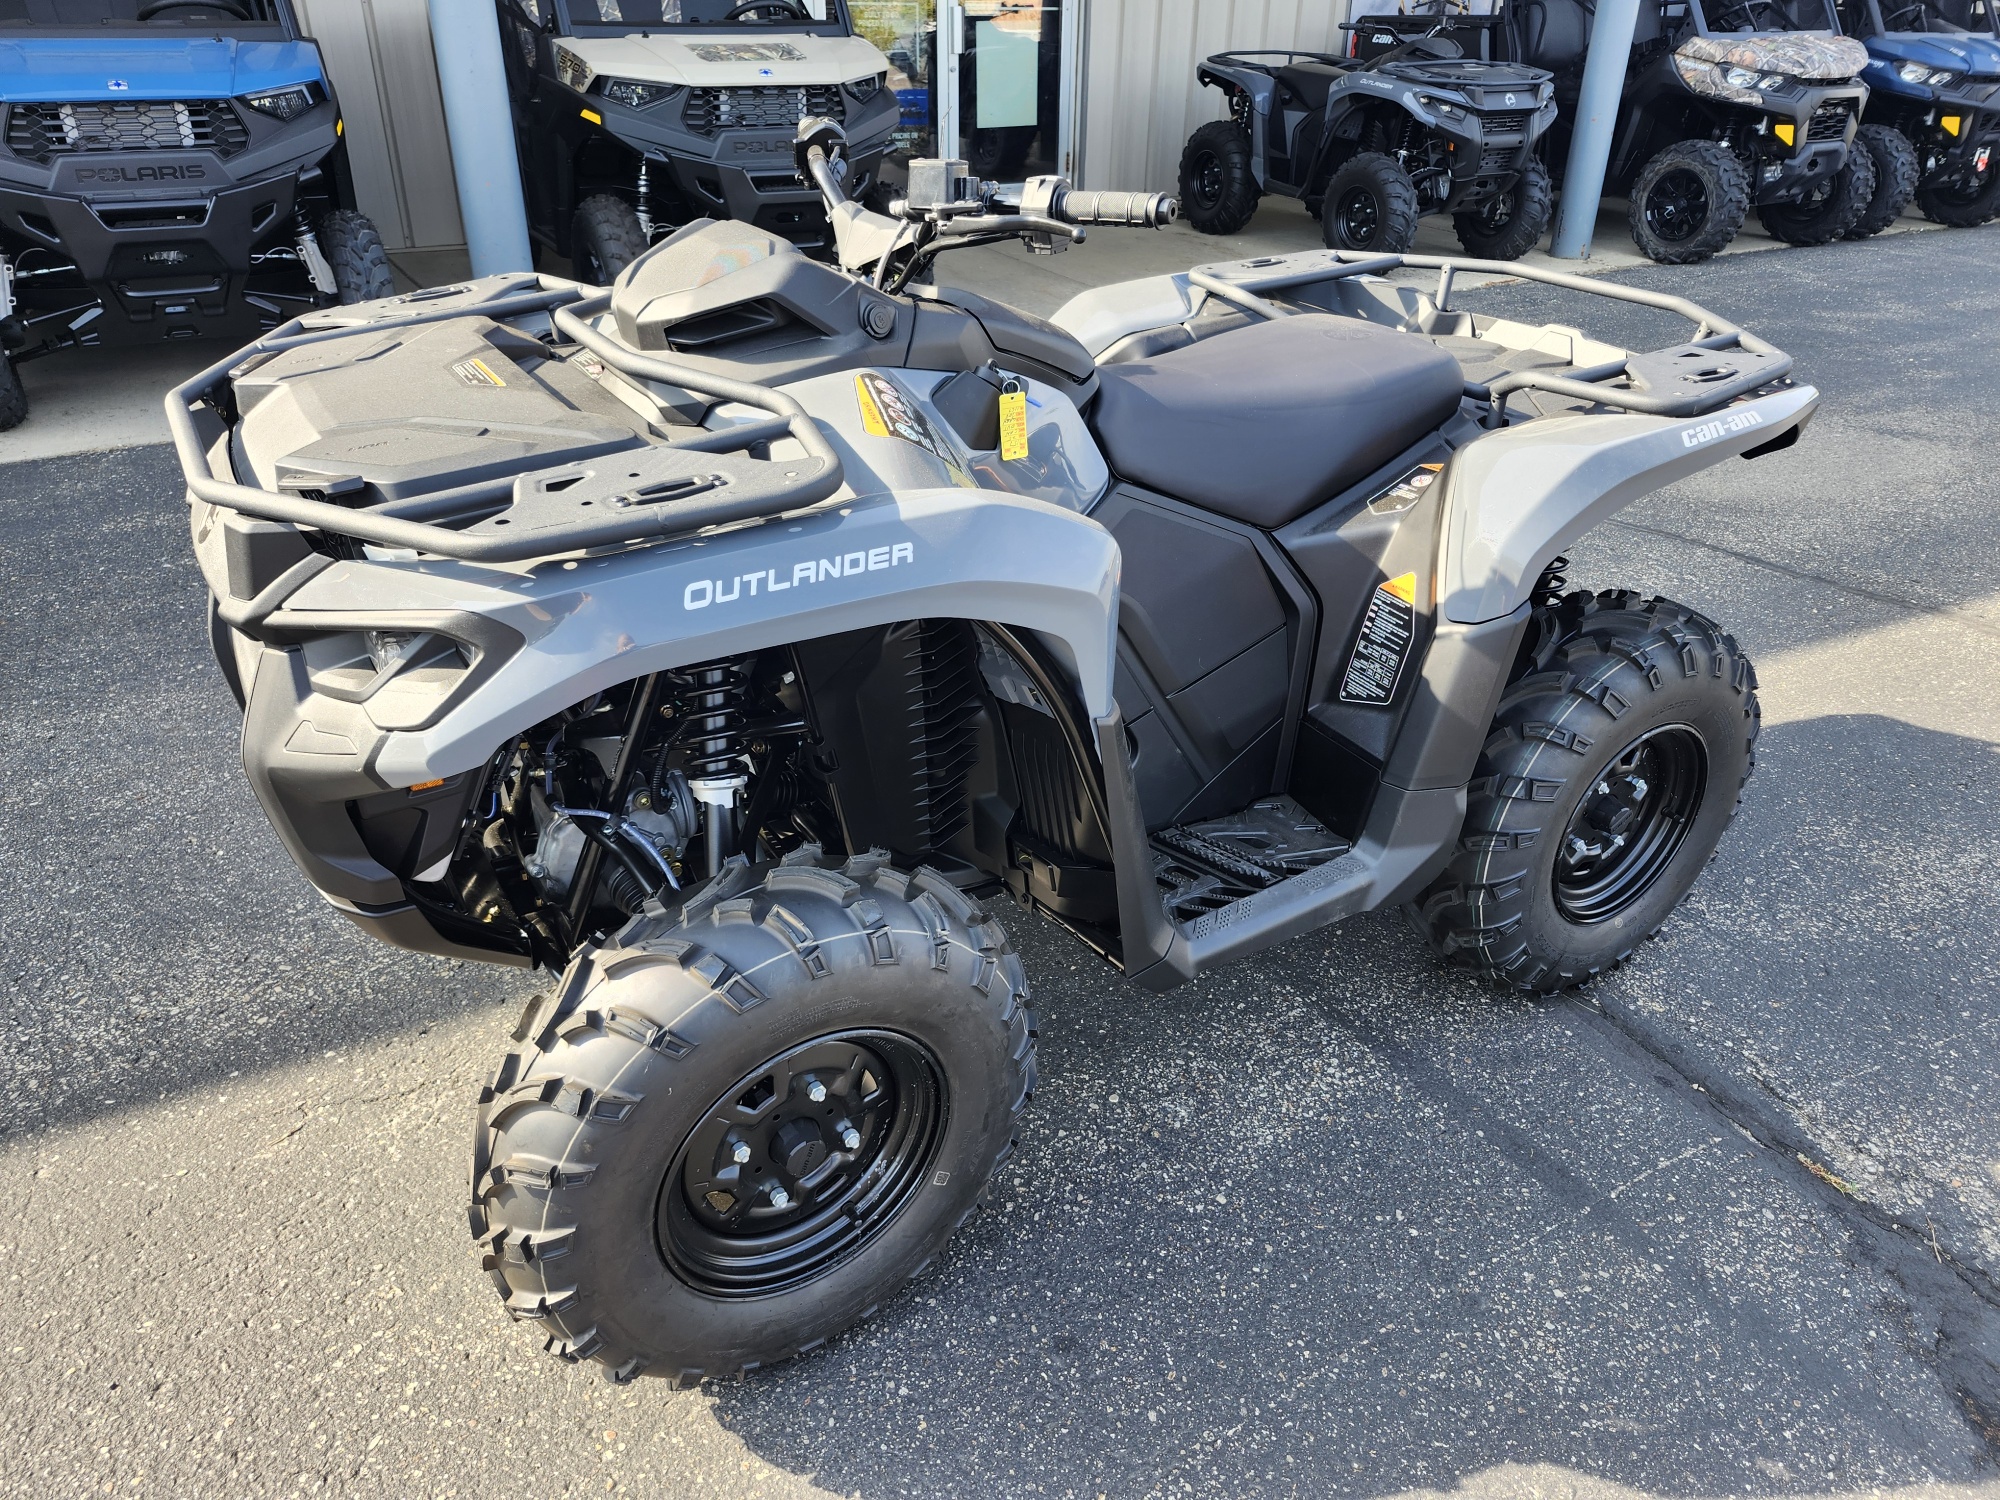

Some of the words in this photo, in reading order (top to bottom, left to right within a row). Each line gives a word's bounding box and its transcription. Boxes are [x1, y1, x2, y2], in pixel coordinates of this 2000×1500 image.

[559, 53, 581, 74] 570
[75, 164, 207, 184] POLARIS
[1681, 410, 1763, 448] can-am
[683, 541, 914, 611] OUTLANDER
